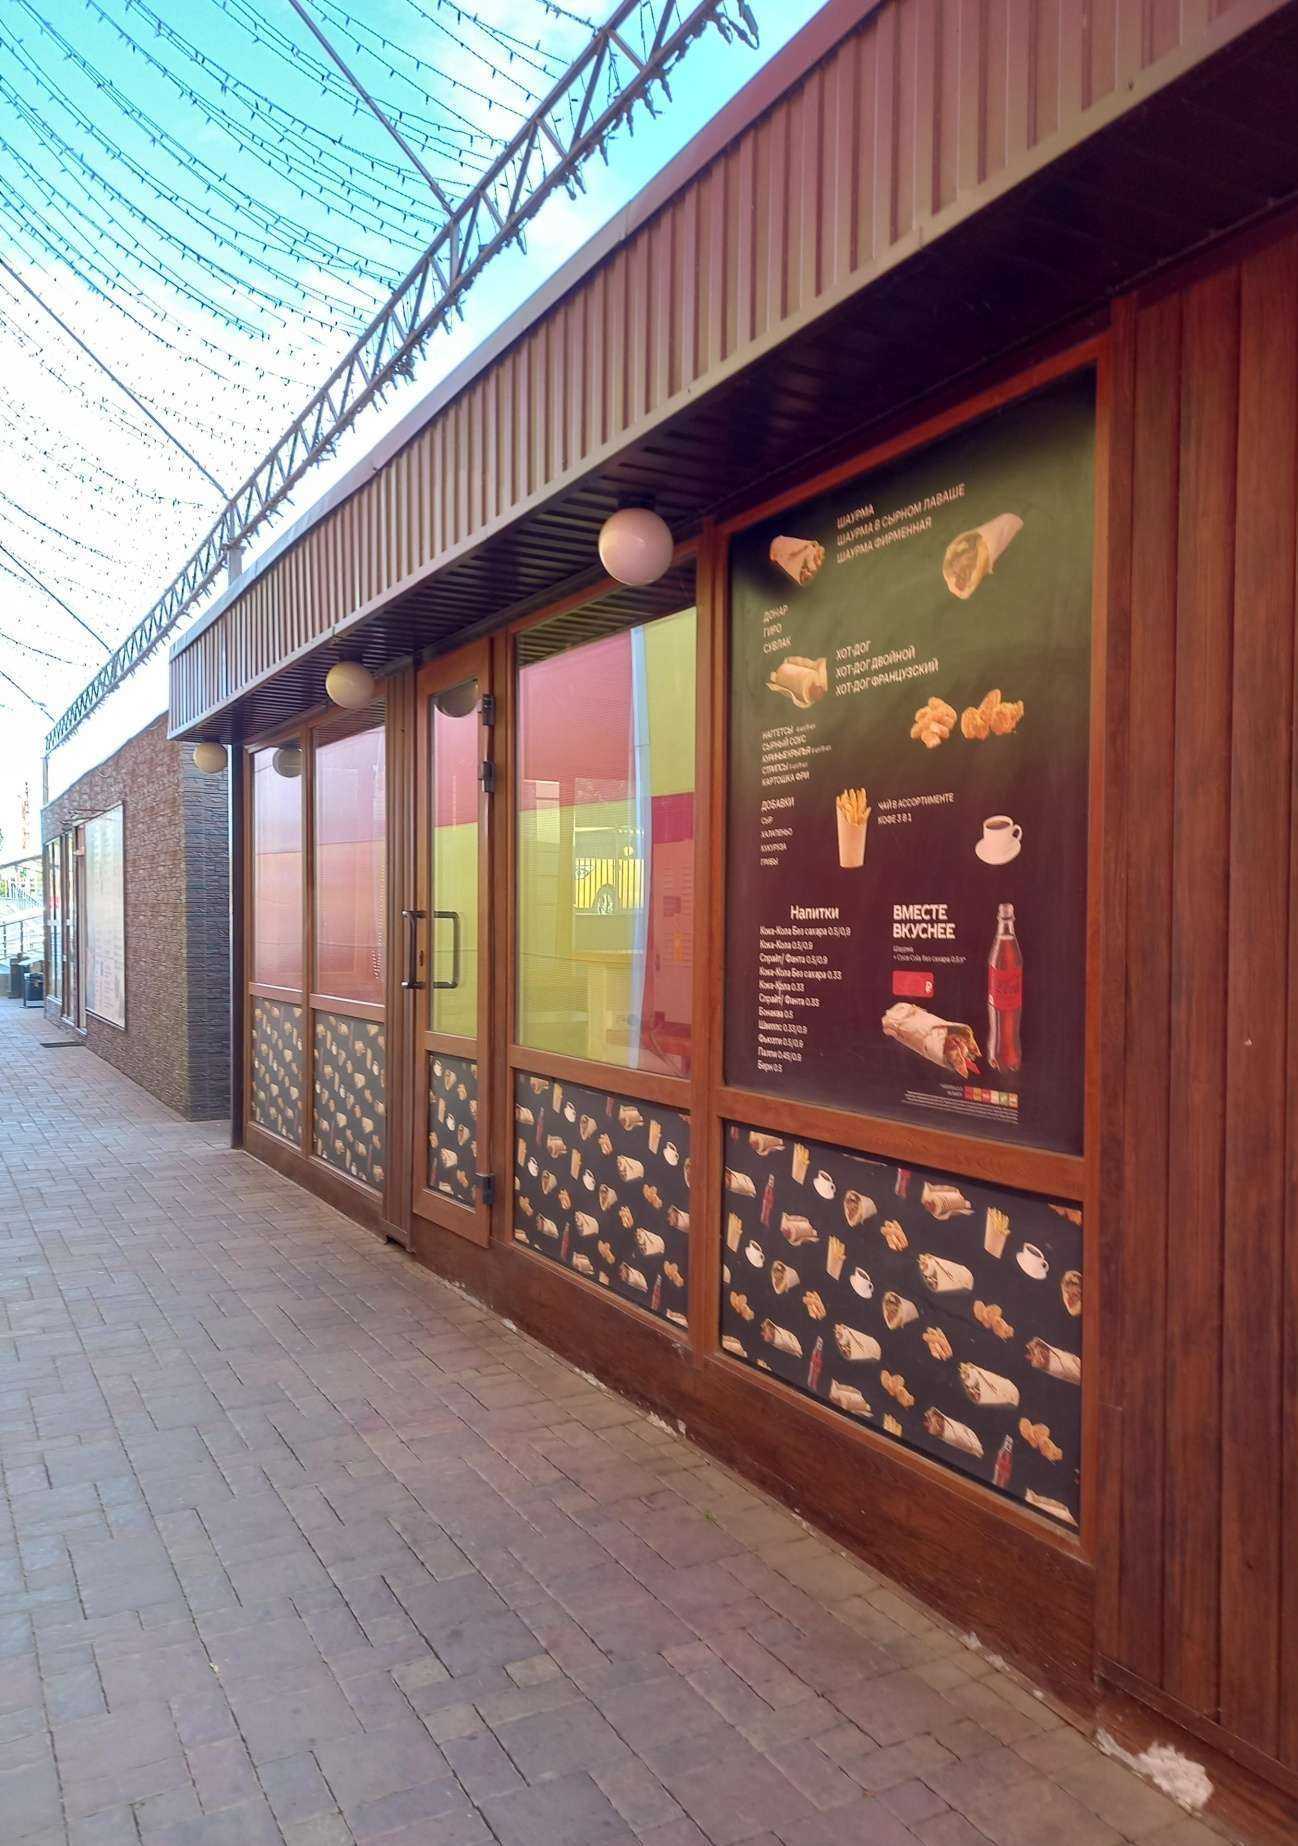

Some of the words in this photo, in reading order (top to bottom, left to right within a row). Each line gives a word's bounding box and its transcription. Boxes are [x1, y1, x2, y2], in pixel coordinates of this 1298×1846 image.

[837, 523, 873, 546] ШАУРМА
[881, 502, 921, 527] СЫРНОМ
[923, 483, 965, 511] ЛАВАШЕ
[837, 504, 875, 529] ШАУРМА
[837, 541, 873, 564] ШАУРМА
[874, 516, 932, 548] ФИРМЕННАЯ
[836, 641, 871, 661] ХОТ-ДОГ
[836, 659, 870, 679] ХОТ-ДОГ
[871, 645, 915, 671] ДВОЙНОЙ
[836, 677, 870, 697] ХОТ-ДОГ
[871, 658, 939, 688] ФРАНЦУЗСКИЙ
[790, 904, 840, 920] Напитки
[893, 904, 948, 921] ВМЕСТЕ
[893, 923, 956, 939] ВКУСНЕЕ
